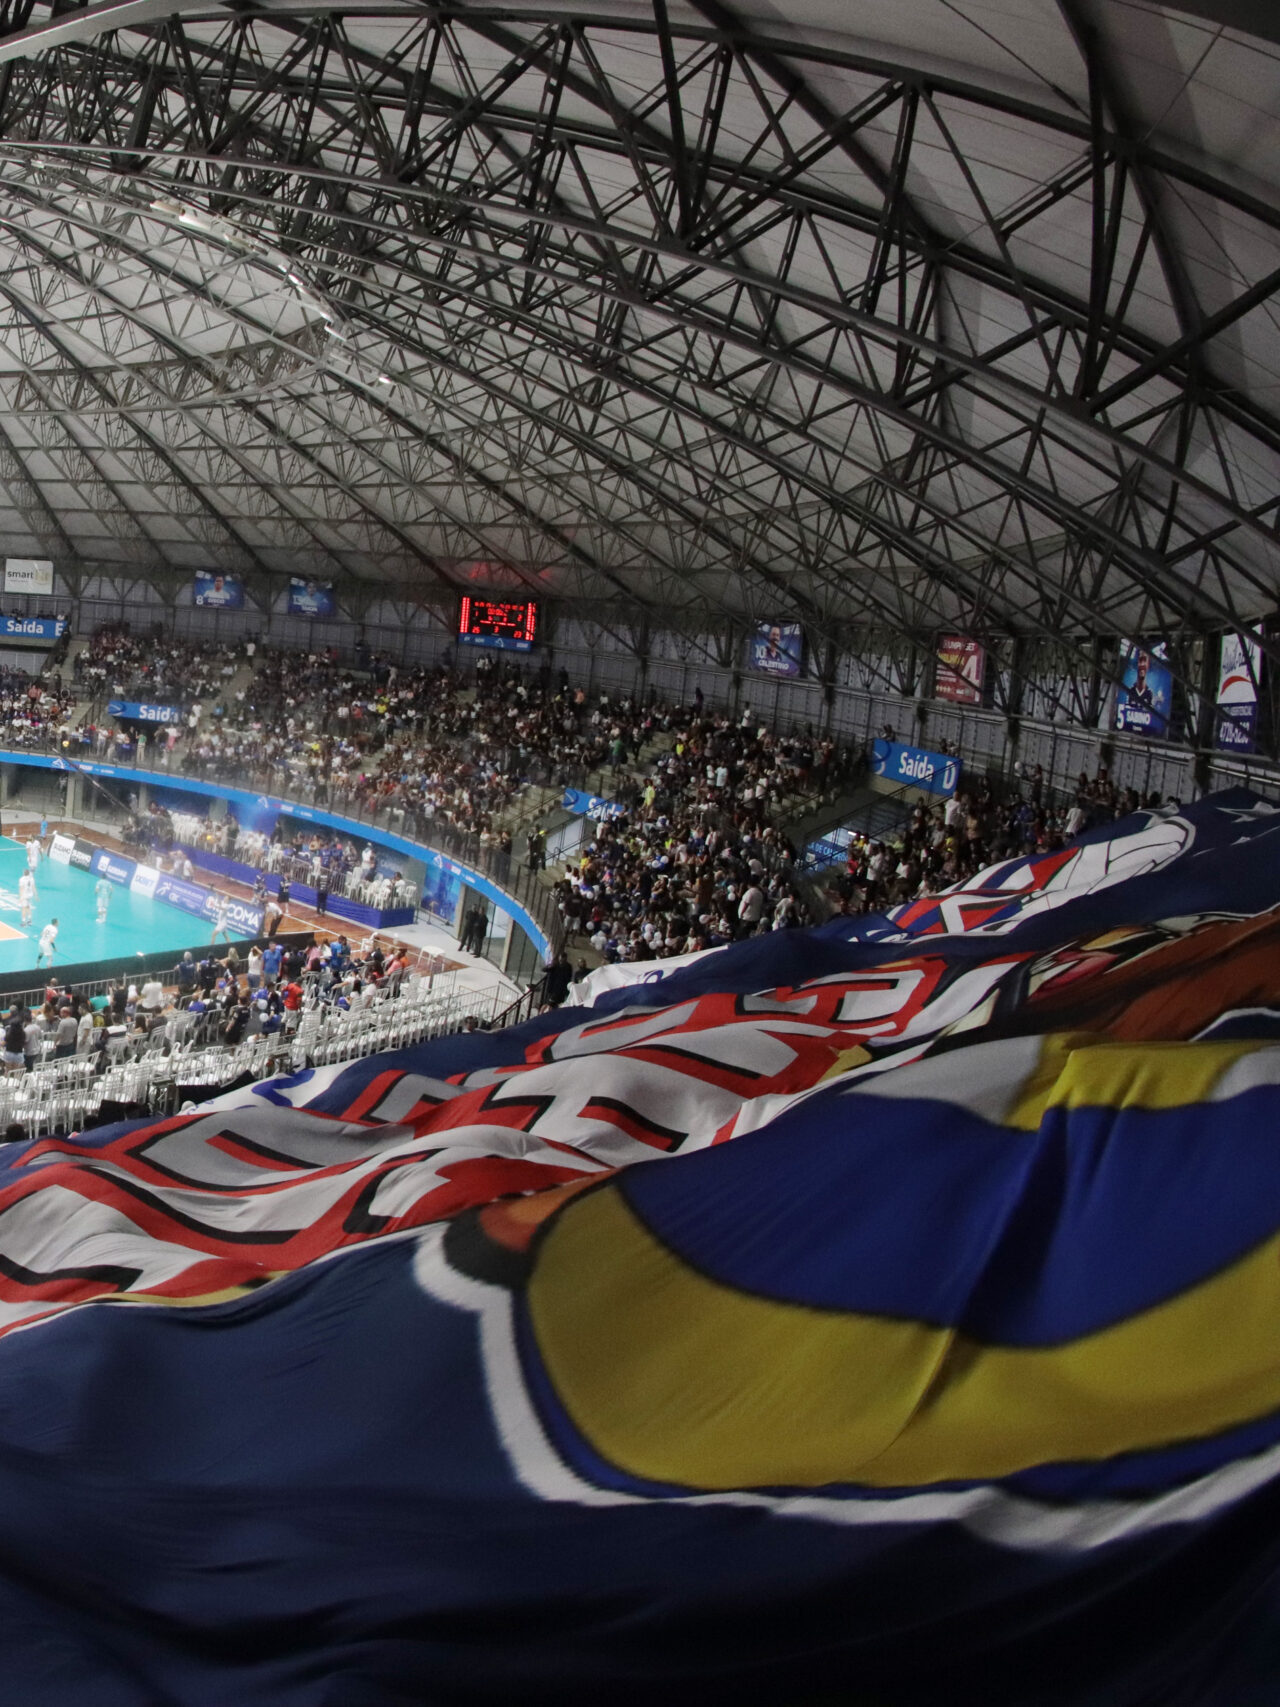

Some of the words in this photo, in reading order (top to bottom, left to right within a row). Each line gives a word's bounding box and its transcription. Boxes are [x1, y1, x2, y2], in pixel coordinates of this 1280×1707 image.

[7, 570, 34, 579] smart
[196, 595, 204, 605] 8
[6, 620, 44, 634] Saída
[55, 622, 63, 636] E
[755, 644, 767, 659] 10
[1117, 703, 1125, 729] 5
[1126, 711, 1151, 725] SABINO
[899, 751, 935, 782] Saída
[942, 761, 956, 790] D
